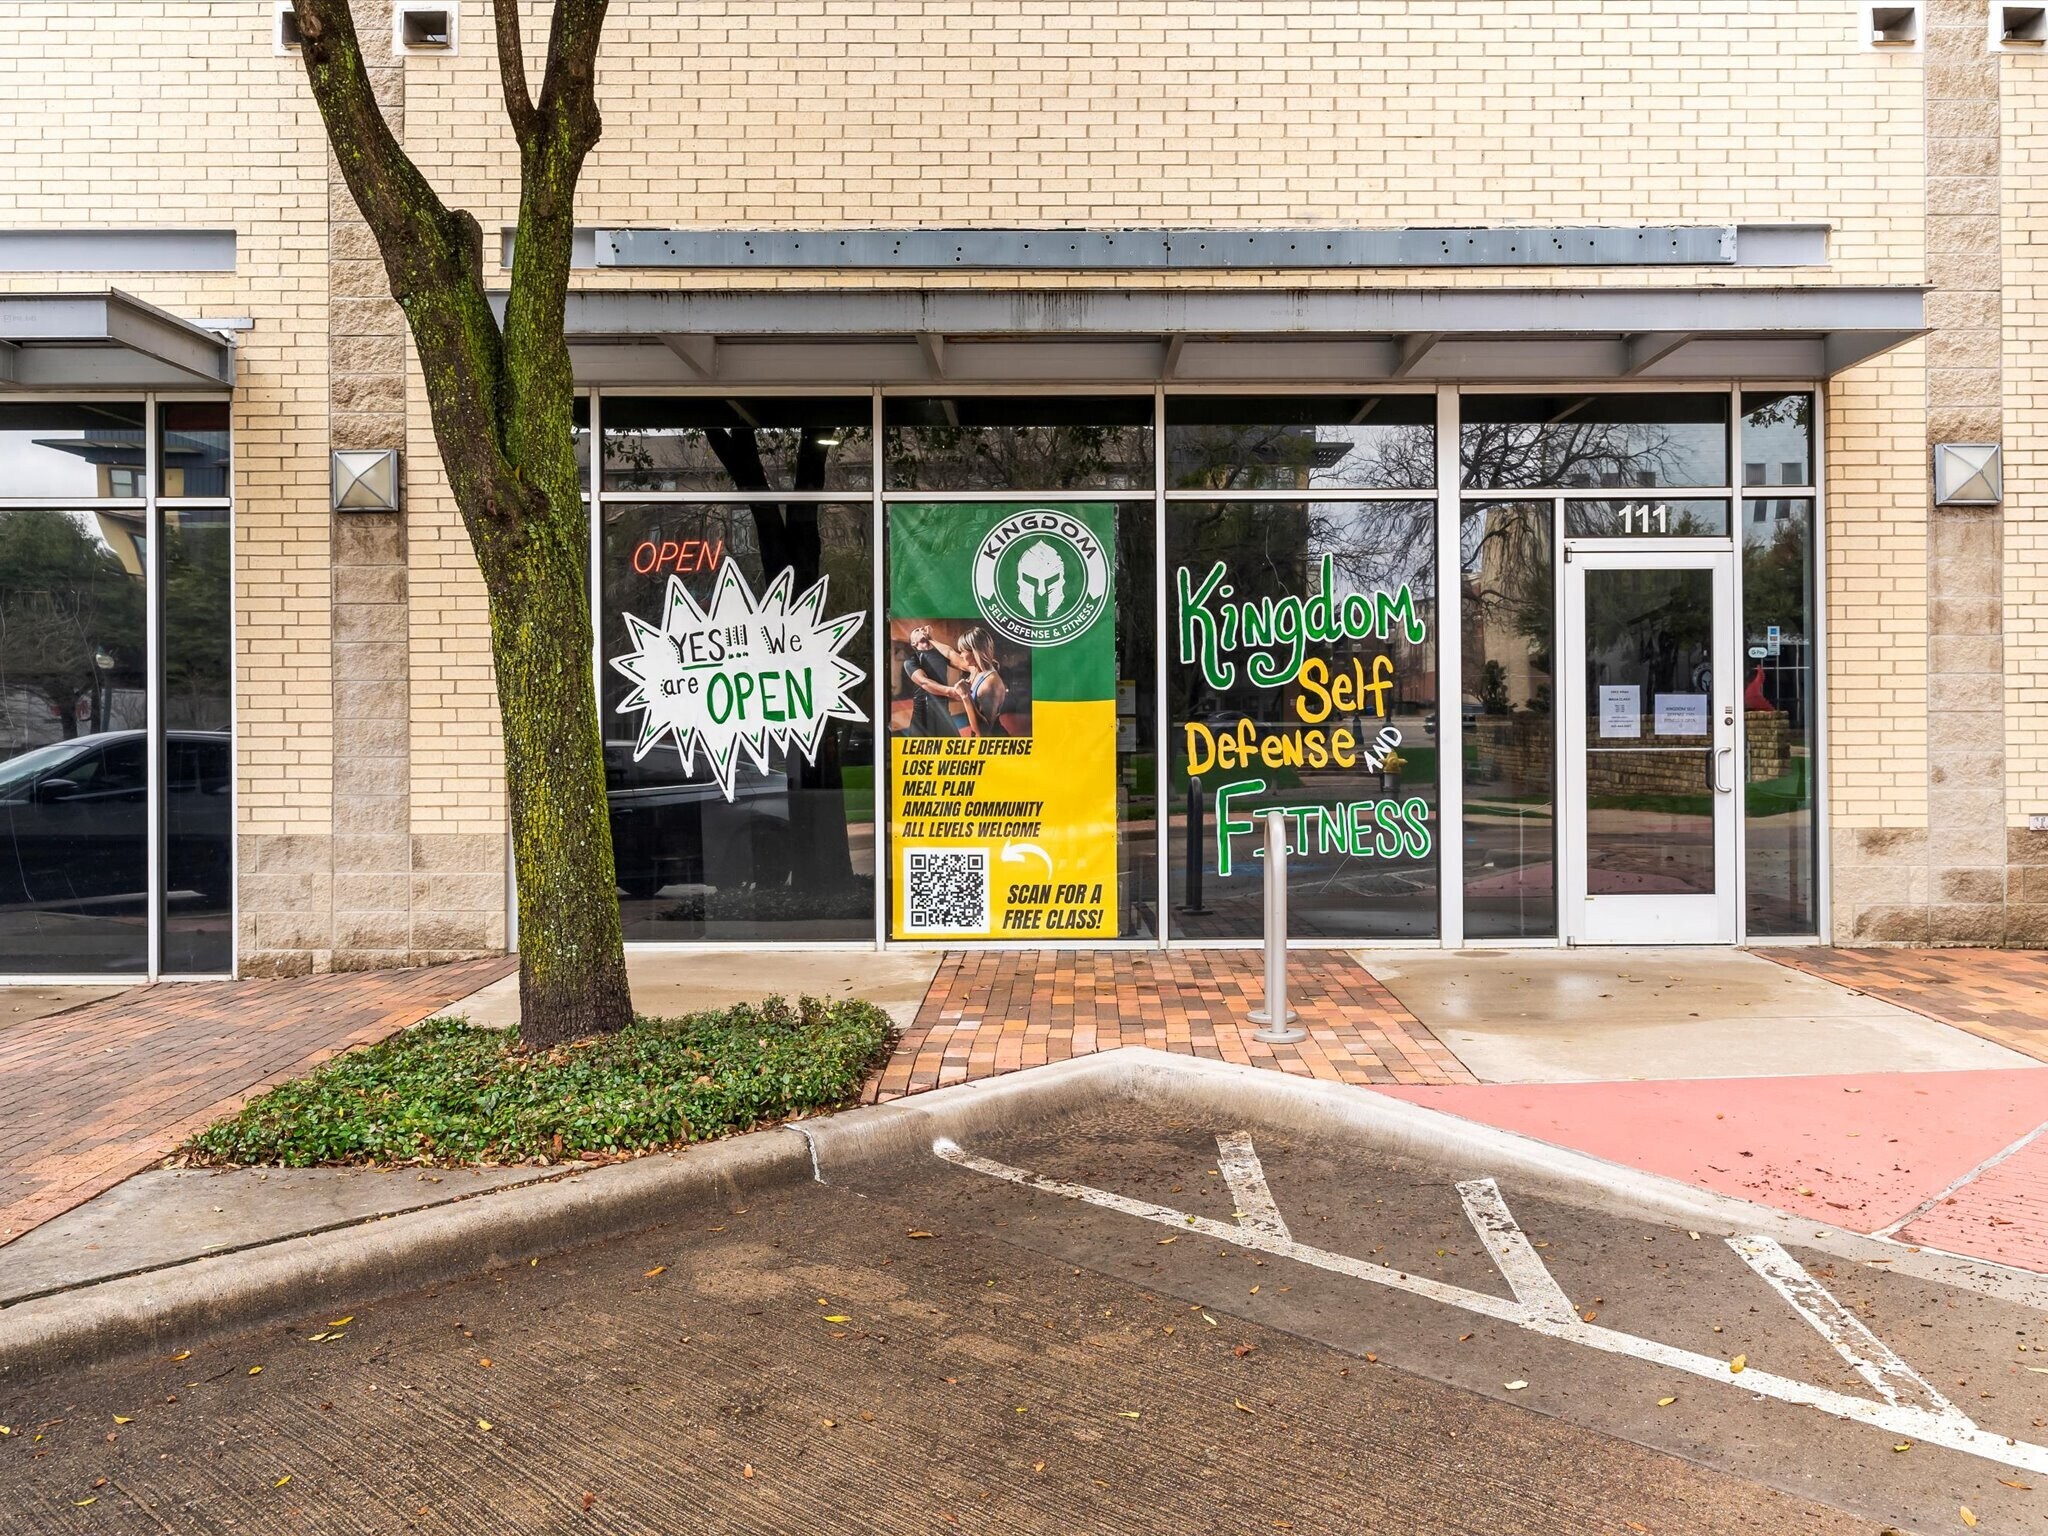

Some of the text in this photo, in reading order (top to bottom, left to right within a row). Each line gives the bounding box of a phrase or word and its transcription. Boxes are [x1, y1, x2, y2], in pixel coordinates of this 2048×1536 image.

[1618, 504, 1667, 533] 111
[983, 515, 1097, 560] KINGDOM
[633, 540, 723, 574] OPEN
[988, 603, 1095, 639] SELF DEFENSE & FITNESS
[667, 623, 803, 664] YES!!! We
[661, 667, 814, 725] are OPEN
[1296, 655, 1394, 724] Self
[902, 739, 1033, 756] LEARN SELF DEFENSE
[1364, 726, 1403, 774] AND
[902, 760, 986, 776] LOSE WEIGHT
[902, 781, 975, 796] MEAL PLAN
[902, 801, 1044, 817] AMAZING COMMUNITY
[902, 822, 1042, 838] ALL LEVELS WELCOME
[1007, 884, 1103, 905] SCAN FOR A
[1002, 909, 1104, 930] FREE CLASS!
